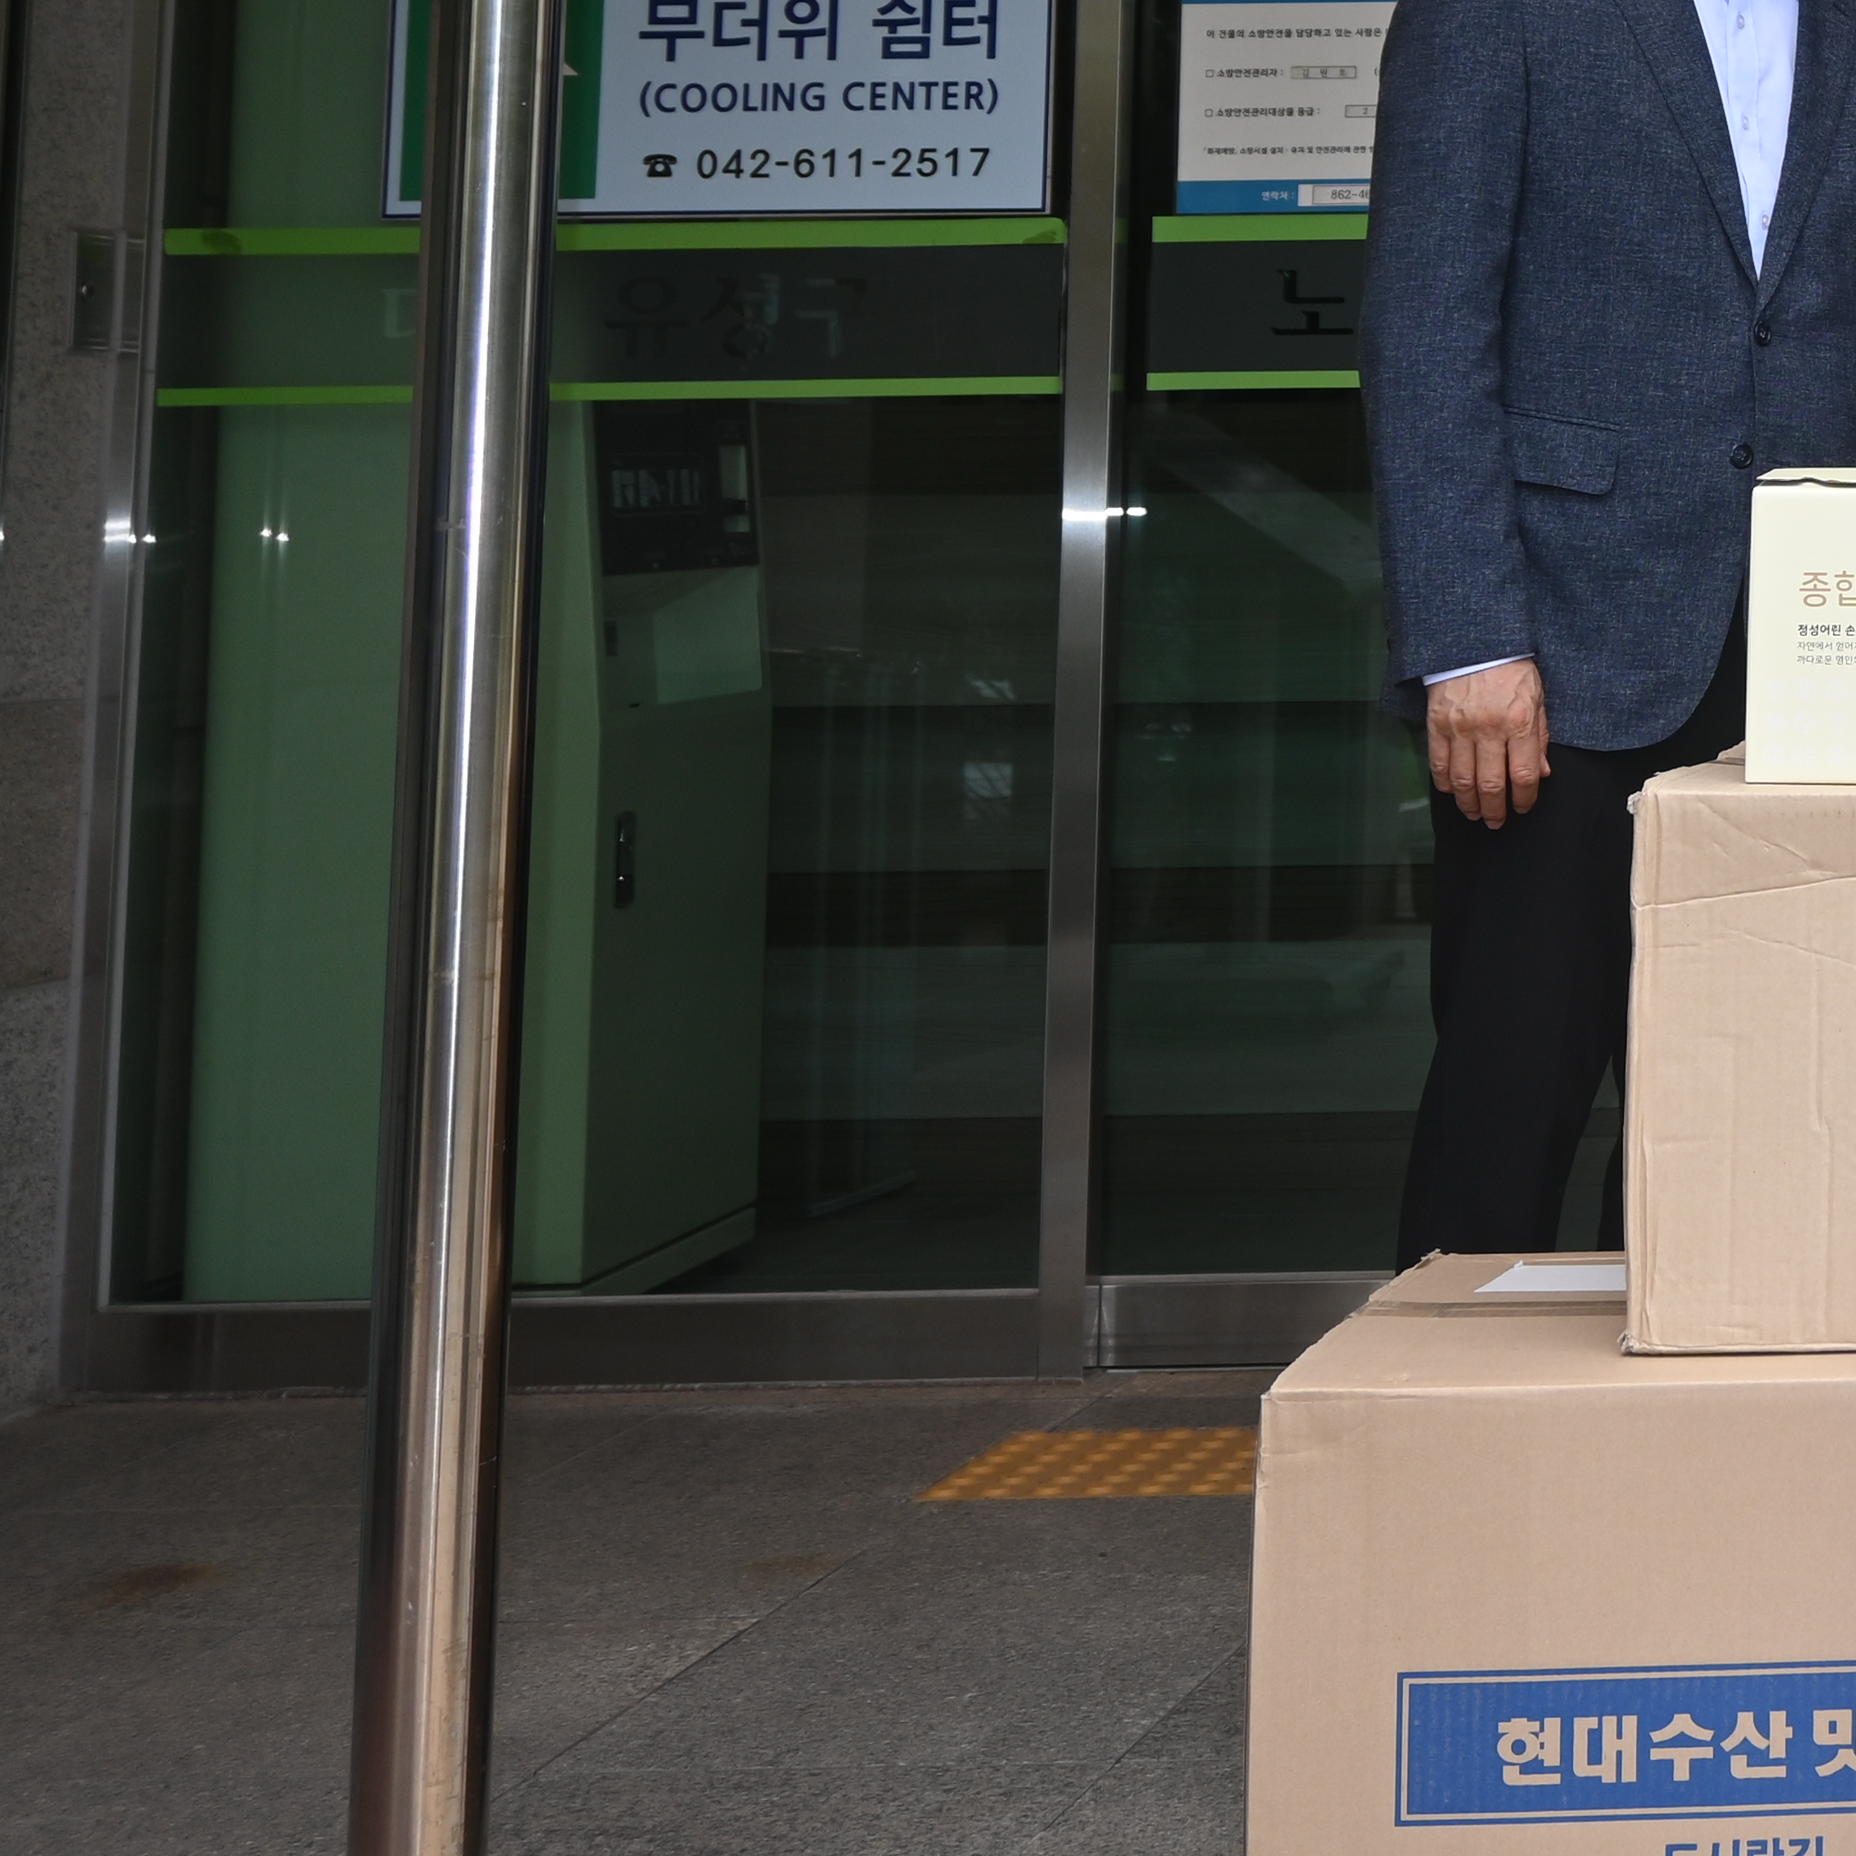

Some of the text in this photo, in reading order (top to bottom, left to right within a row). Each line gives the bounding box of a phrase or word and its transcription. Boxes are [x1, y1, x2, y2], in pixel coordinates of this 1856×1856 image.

[1248, 28, 1292, 39] 소방안전을
[639, 77, 999, 118] (COOLING CENTER)
[695, 145, 991, 181] 042-611-2517
[1797, 624, 1842, 637] 정성어린
[1497, 1711, 1793, 1787] 현대수산
